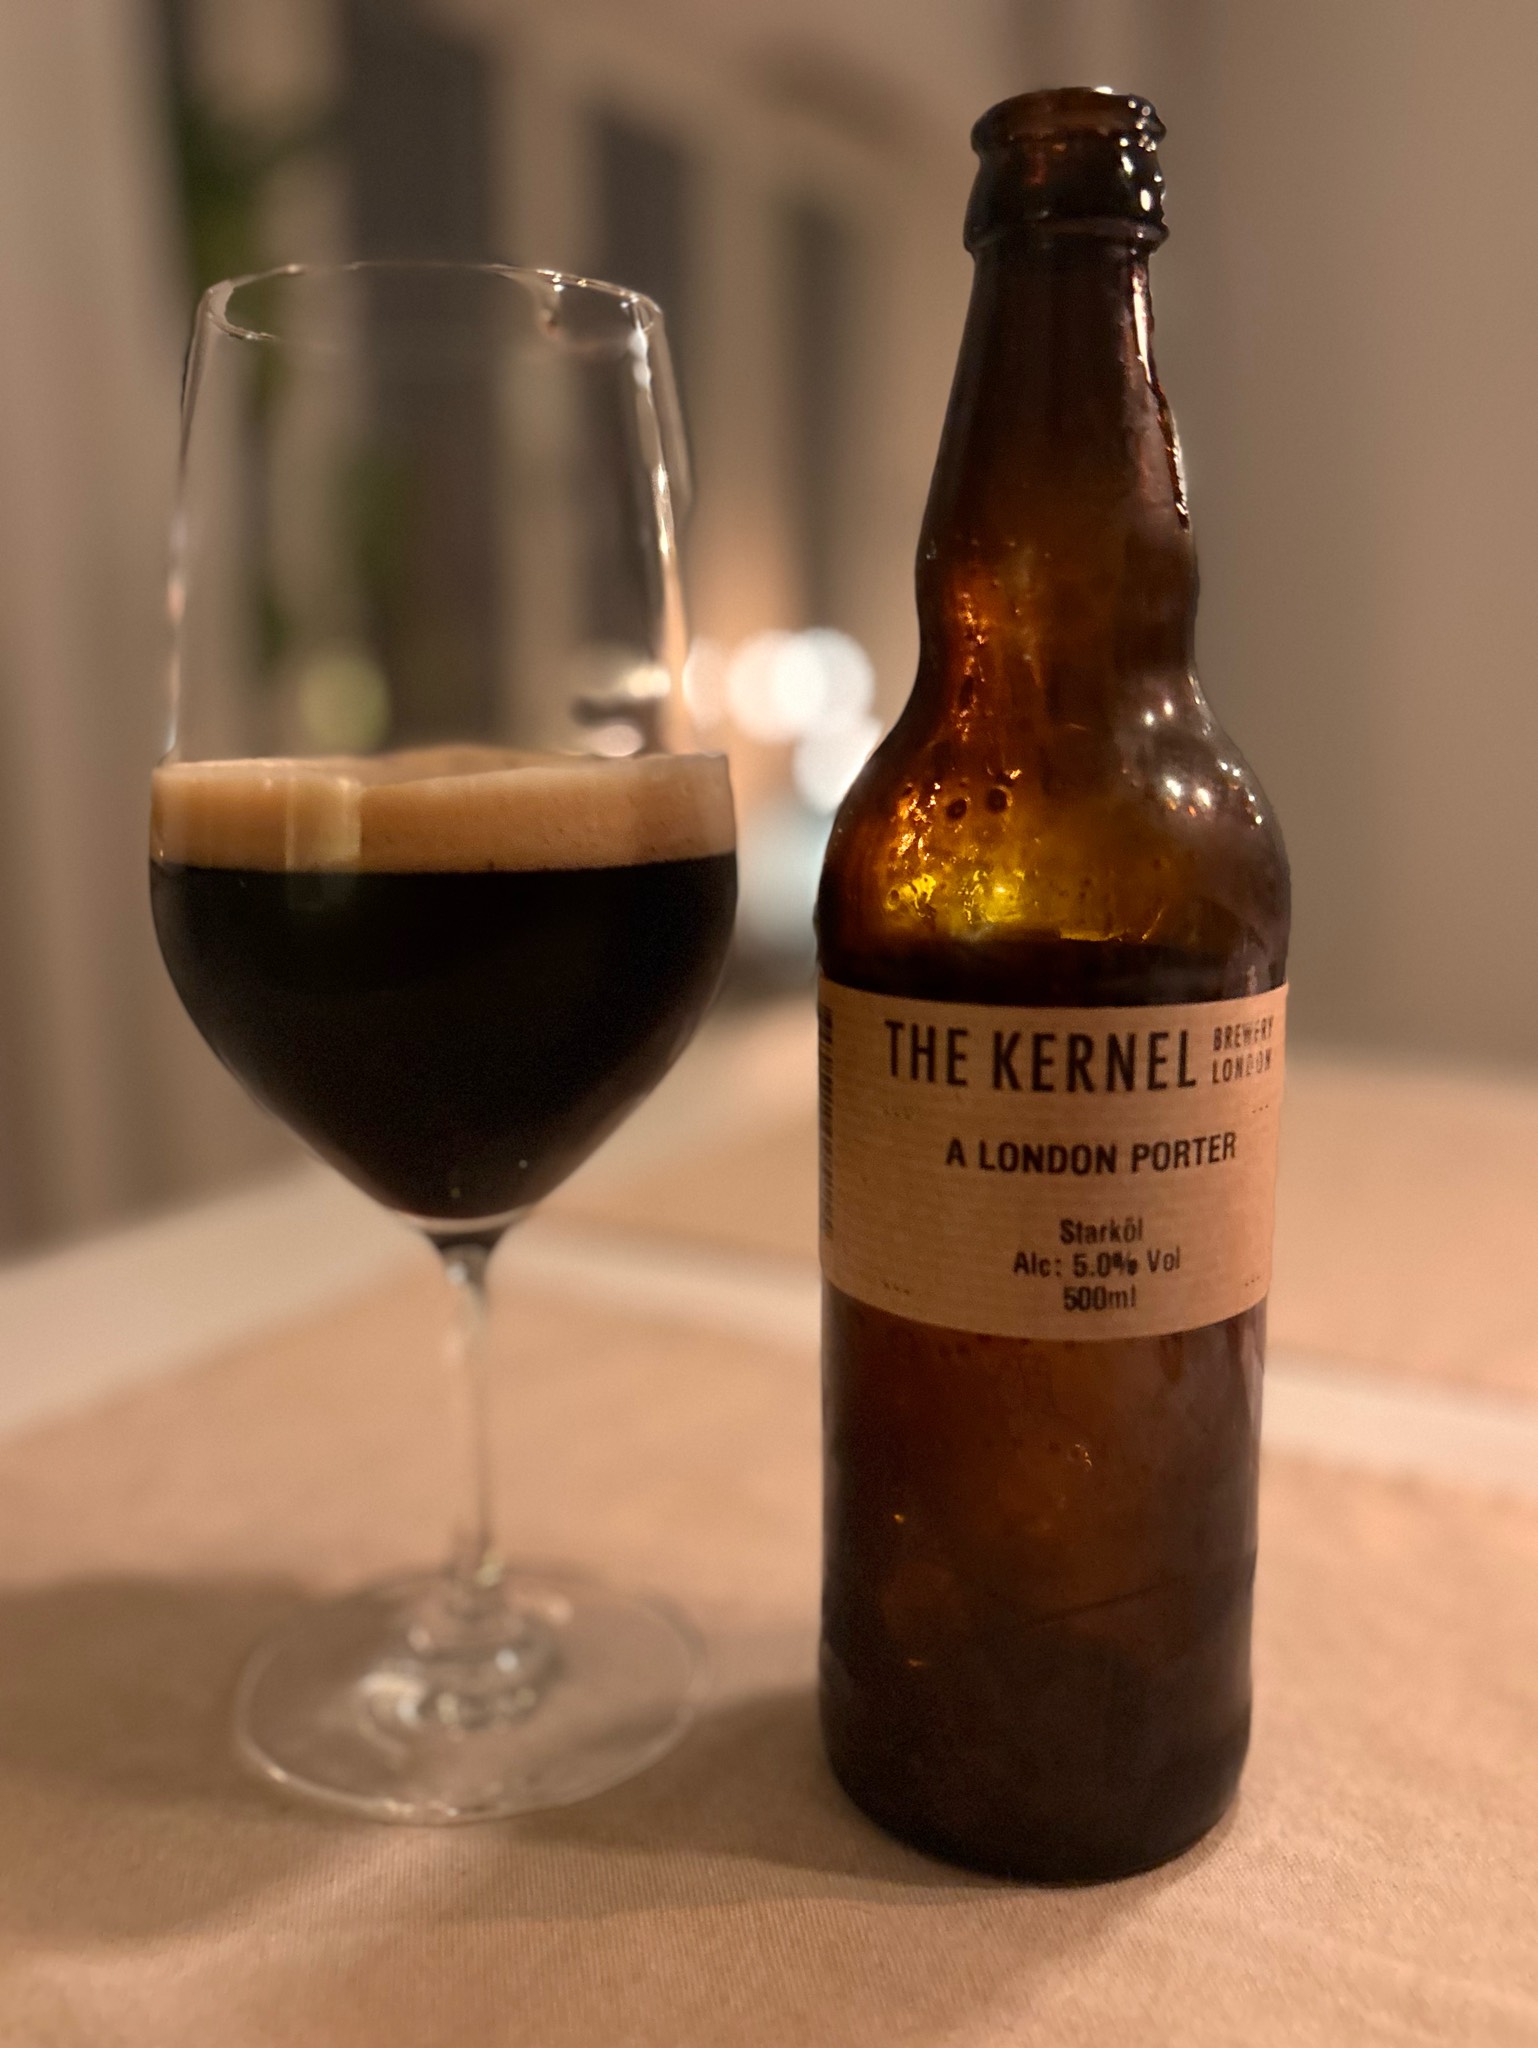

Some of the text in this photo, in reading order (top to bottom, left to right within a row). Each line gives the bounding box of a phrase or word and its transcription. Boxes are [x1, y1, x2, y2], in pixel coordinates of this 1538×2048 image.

[1213, 1014, 1274, 1052] BREWERY
[885, 1020, 1197, 1093] THE KERNEL
[1212, 1048, 1272, 1085] LONDON
[946, 1132, 1237, 1177] A LONDON PORTER
[1060, 1215, 1144, 1245] Starköl
[1013, 1245, 1181, 1278] Alc: 5.0% Vol
[1063, 1284, 1136, 1312] 500ml
